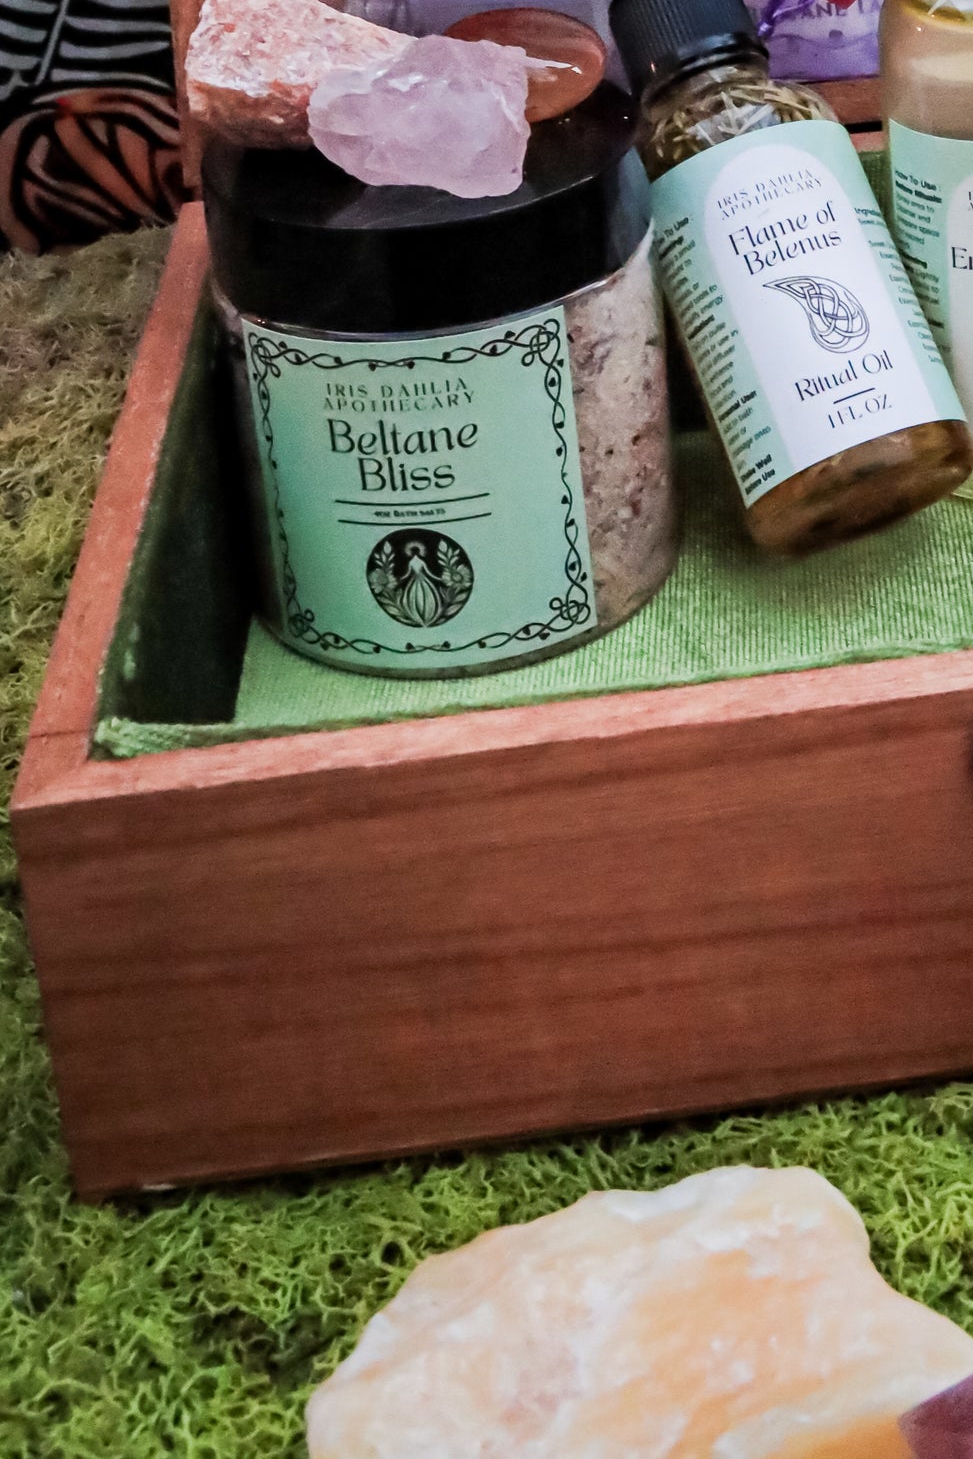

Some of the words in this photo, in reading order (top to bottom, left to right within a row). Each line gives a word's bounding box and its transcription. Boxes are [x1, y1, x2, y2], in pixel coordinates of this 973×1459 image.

[717, 188, 748, 209] IRIS
[755, 169, 813, 193] DAHLIA
[721, 178, 822, 221] APOTHECARY
[729, 213, 809, 255] Flame
[816, 200, 836, 225] of
[743, 230, 842, 275] Belenus
[327, 383, 368, 398] IRIS
[380, 377, 467, 398] DAHLIA
[795, 360, 858, 401] Ritual
[862, 350, 893, 374] Oil
[324, 390, 474, 413] APOTHECARY
[327, 418, 478, 455] Beltane
[357, 456, 455, 492] Bliss
